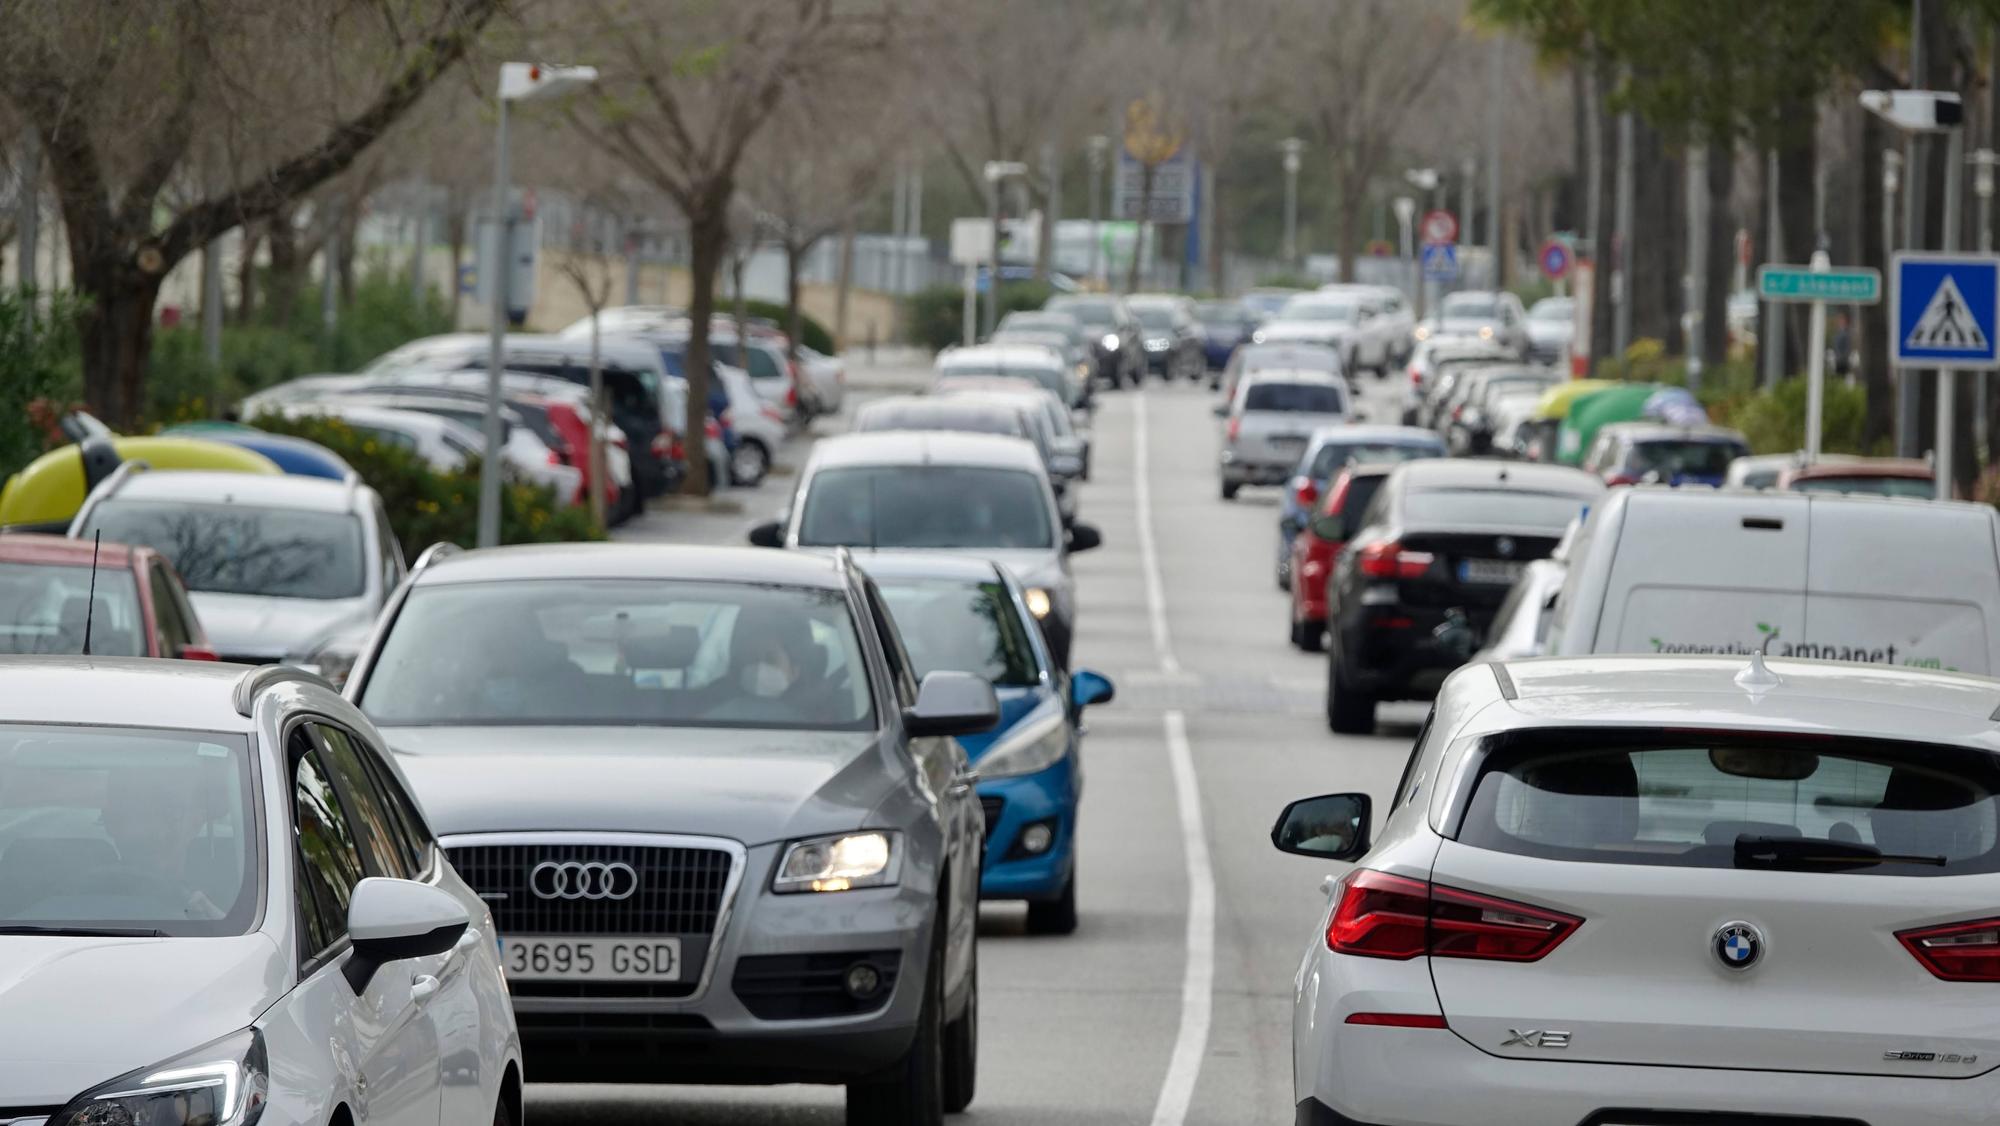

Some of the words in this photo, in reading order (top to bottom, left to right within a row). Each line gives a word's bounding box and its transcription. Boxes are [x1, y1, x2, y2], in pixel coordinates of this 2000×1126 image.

[1722, 927, 1756, 942] BMW
[511, 943, 594, 973] 3695
[611, 944, 673, 974] GSD
[1500, 1028, 1572, 1048] X2
